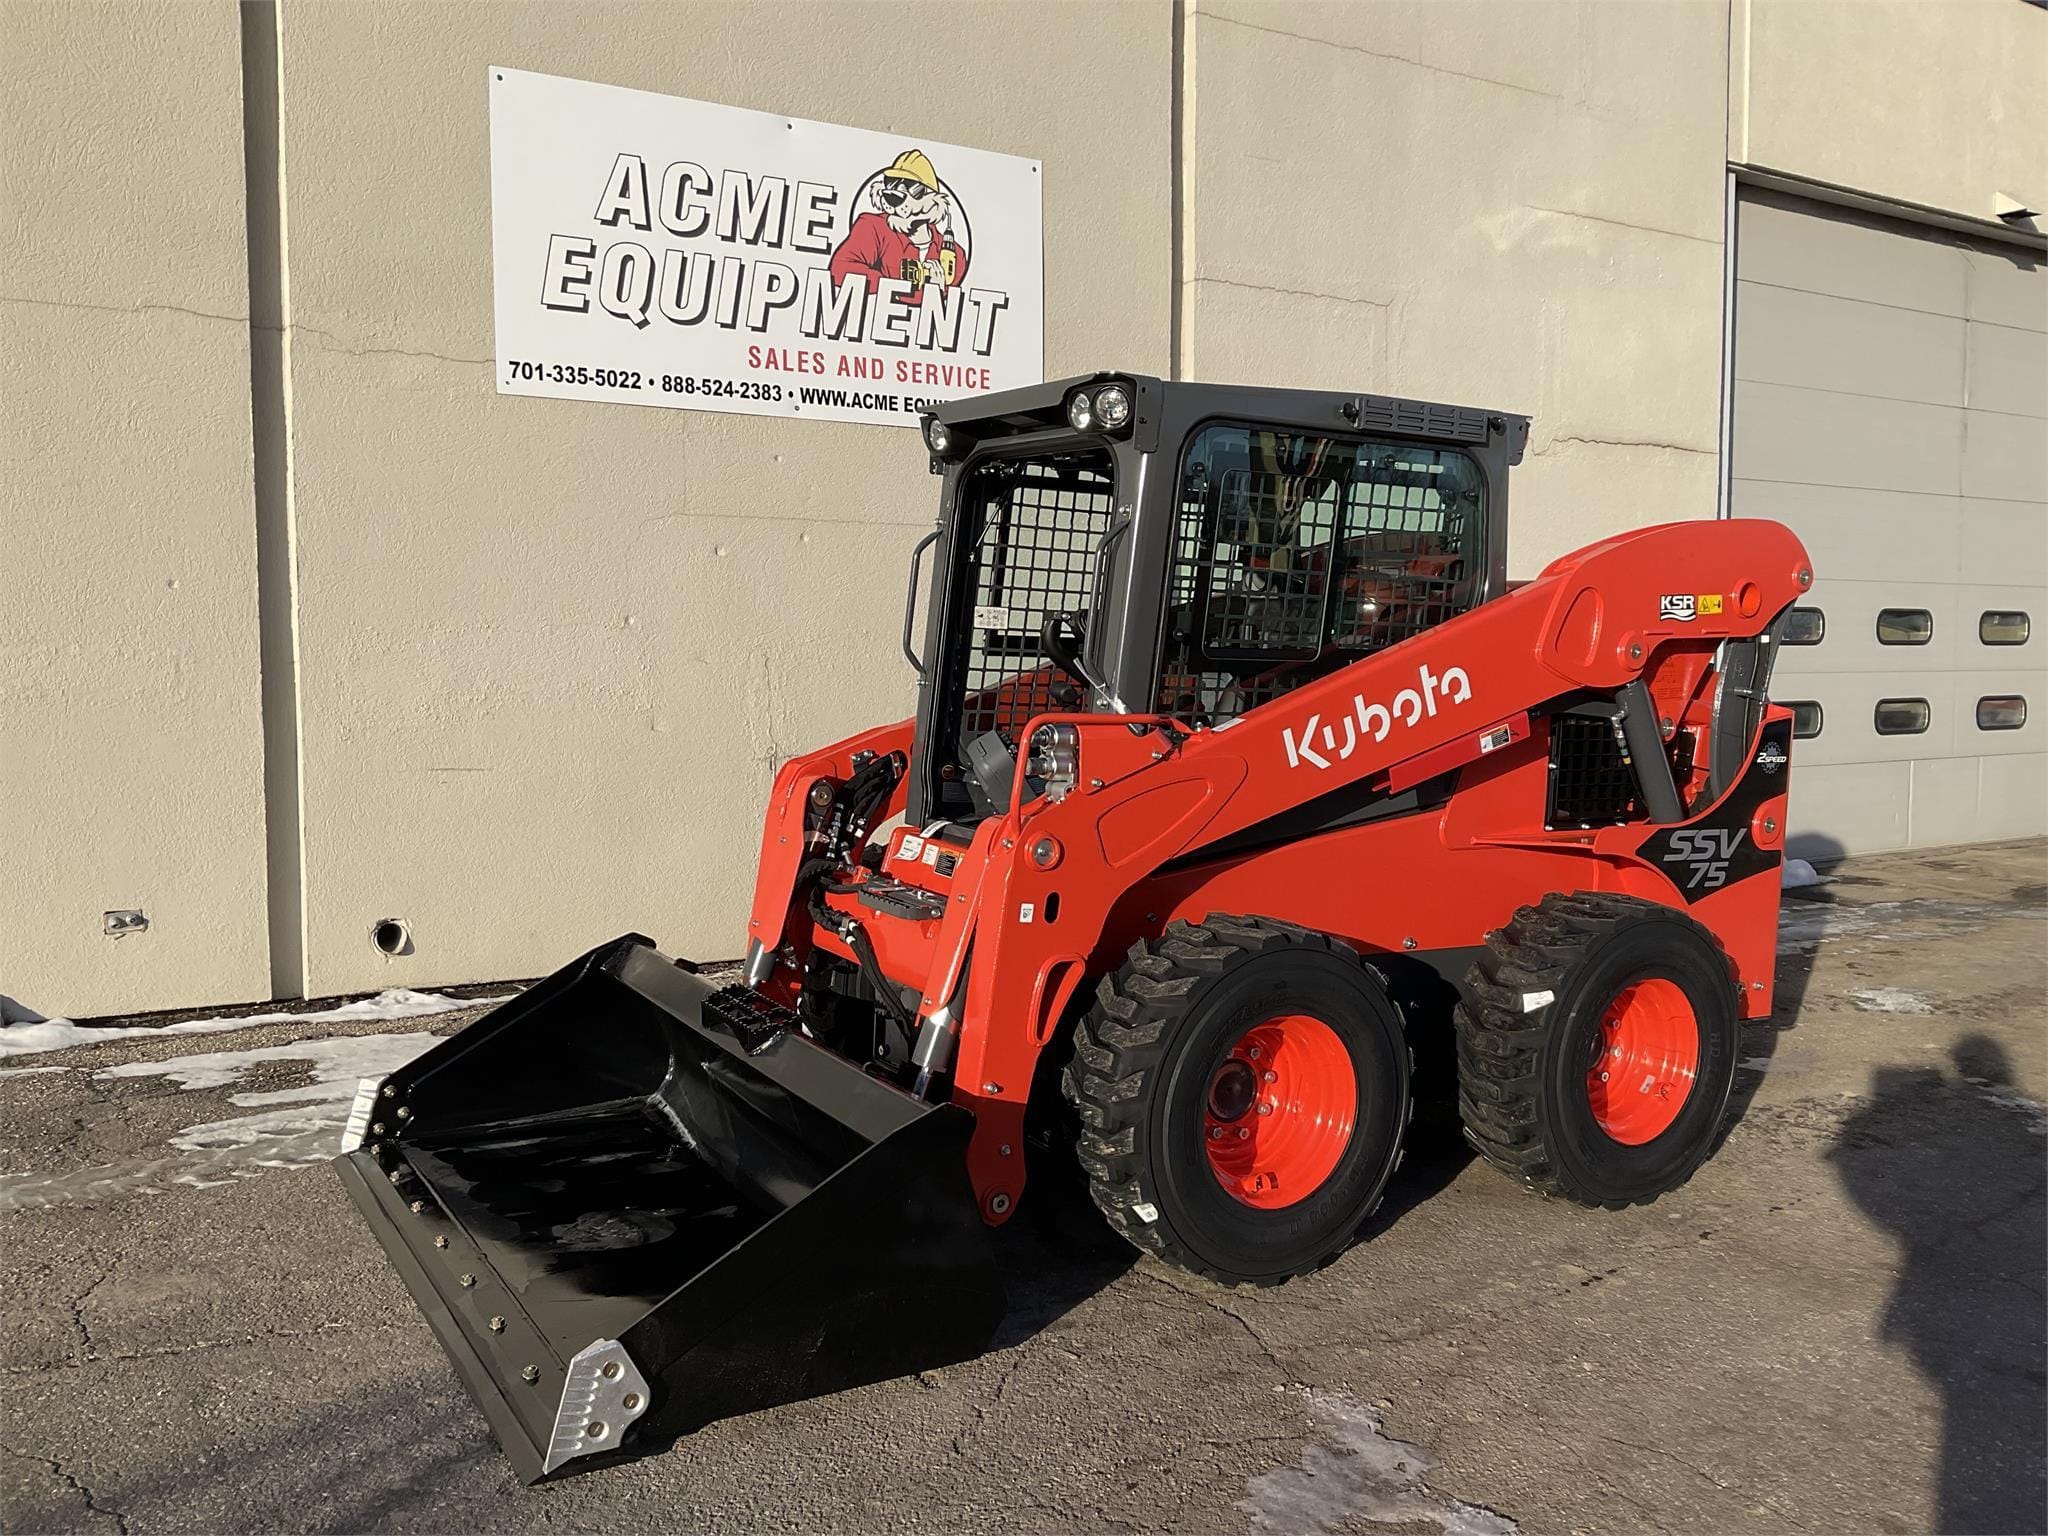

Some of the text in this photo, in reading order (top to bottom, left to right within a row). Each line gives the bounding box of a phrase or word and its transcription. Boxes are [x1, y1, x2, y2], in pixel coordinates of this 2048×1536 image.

[595, 153, 838, 256] ACME
[541, 234, 1009, 356] EQUIPMENT
[508, 361, 642, 389] 701-335-5022
[662, 374, 782, 402] 888-524-2383
[800, 387, 898, 412] WWW.ACME
[748, 345, 991, 389] SALES AND SERVICE
[1661, 595, 1695, 610] KSR
[1282, 663, 1473, 770] Kubota
[1663, 828, 1748, 861] SSV
[1687, 861, 1729, 889] 75
